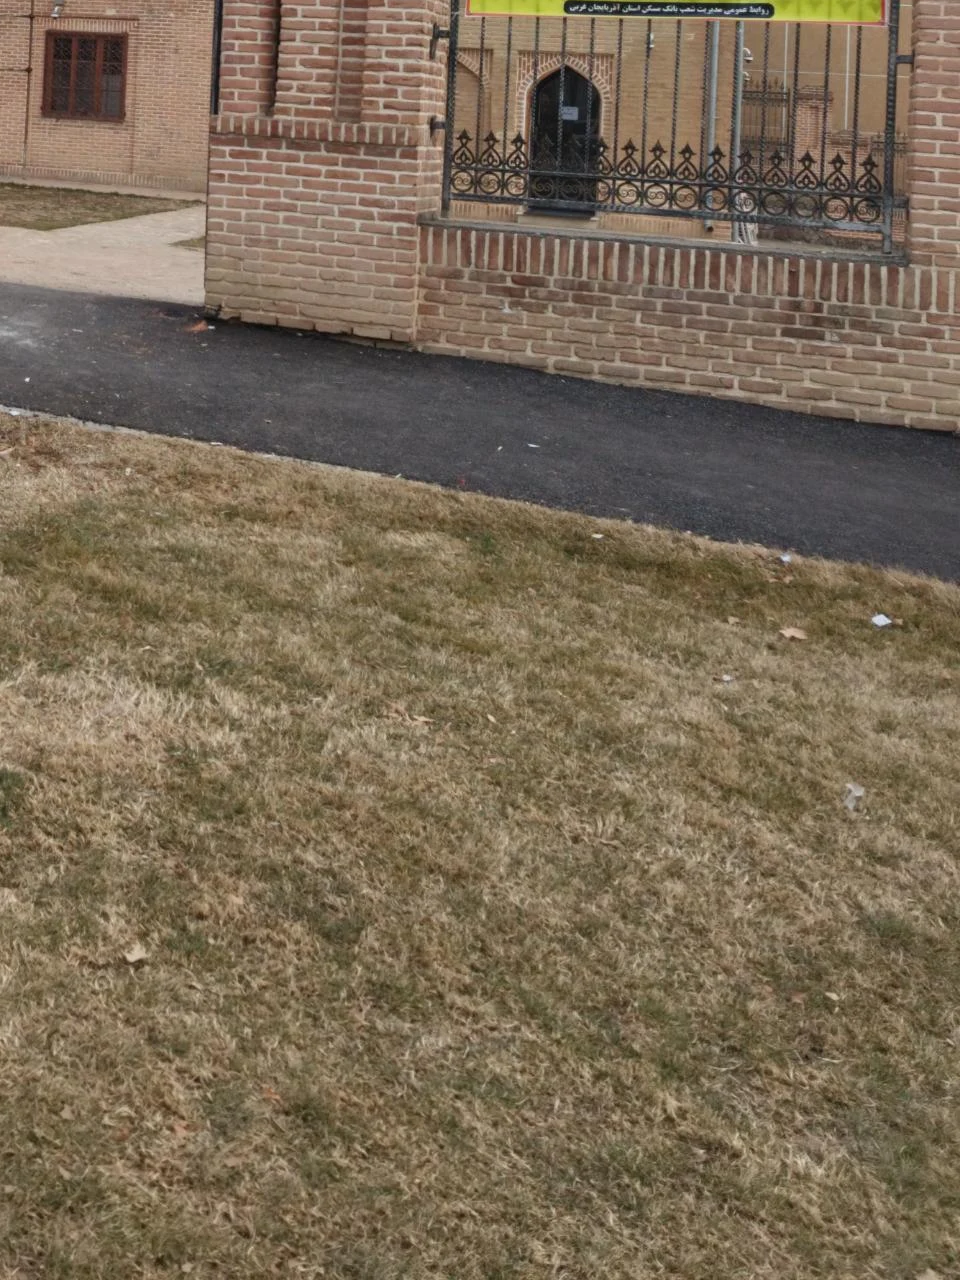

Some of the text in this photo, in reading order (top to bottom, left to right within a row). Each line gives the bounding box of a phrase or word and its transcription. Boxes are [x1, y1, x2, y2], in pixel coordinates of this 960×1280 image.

[569, 3, 587, 13] غربی
[587, 2, 620, 13] آذربایجان
[622, 4, 641, 13] استان
[641, 4, 661, 14] مسکن
[662, 5, 678, 14] بانک
[697, 6, 723, 15] مدیریت
[723, 6, 747, 16] عمومی
[748, 6, 770, 16] روابط
